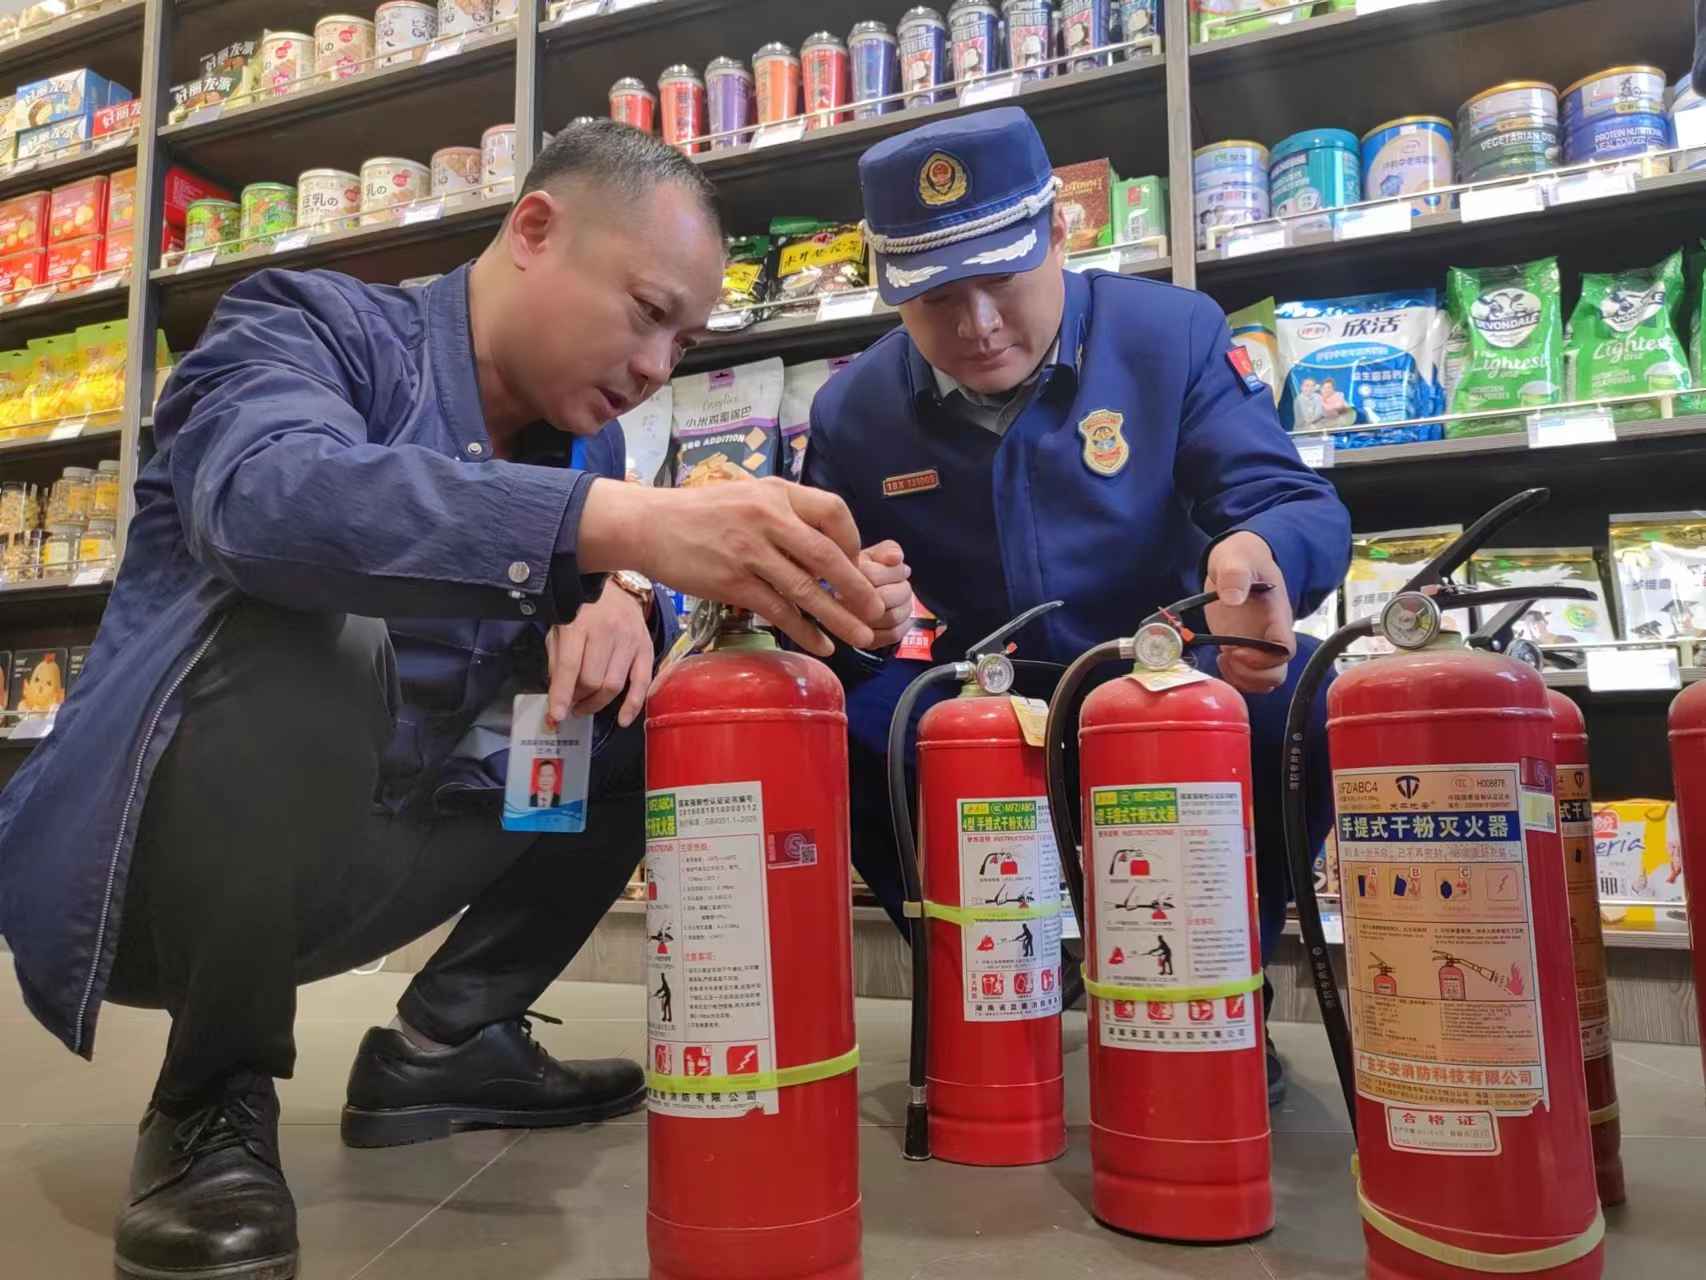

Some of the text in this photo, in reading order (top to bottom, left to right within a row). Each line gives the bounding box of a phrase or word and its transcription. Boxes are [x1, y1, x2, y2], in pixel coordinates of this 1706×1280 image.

[1480, 131, 1541, 152] VEGETARIAN
[1341, 314, 1402, 337] 欣活
[1475, 313, 1539, 330] DEVONDALE
[1593, 329, 1673, 363] Lightest
[1472, 352, 1546, 379] Lightest
[703, 433, 745, 447] ADDITION
[1341, 814, 1509, 840] 手提式干粉灭火器
[1359, 1055, 1533, 1086] 广东天安消防科技有限公司
[1402, 1112, 1476, 1126] 合格证
